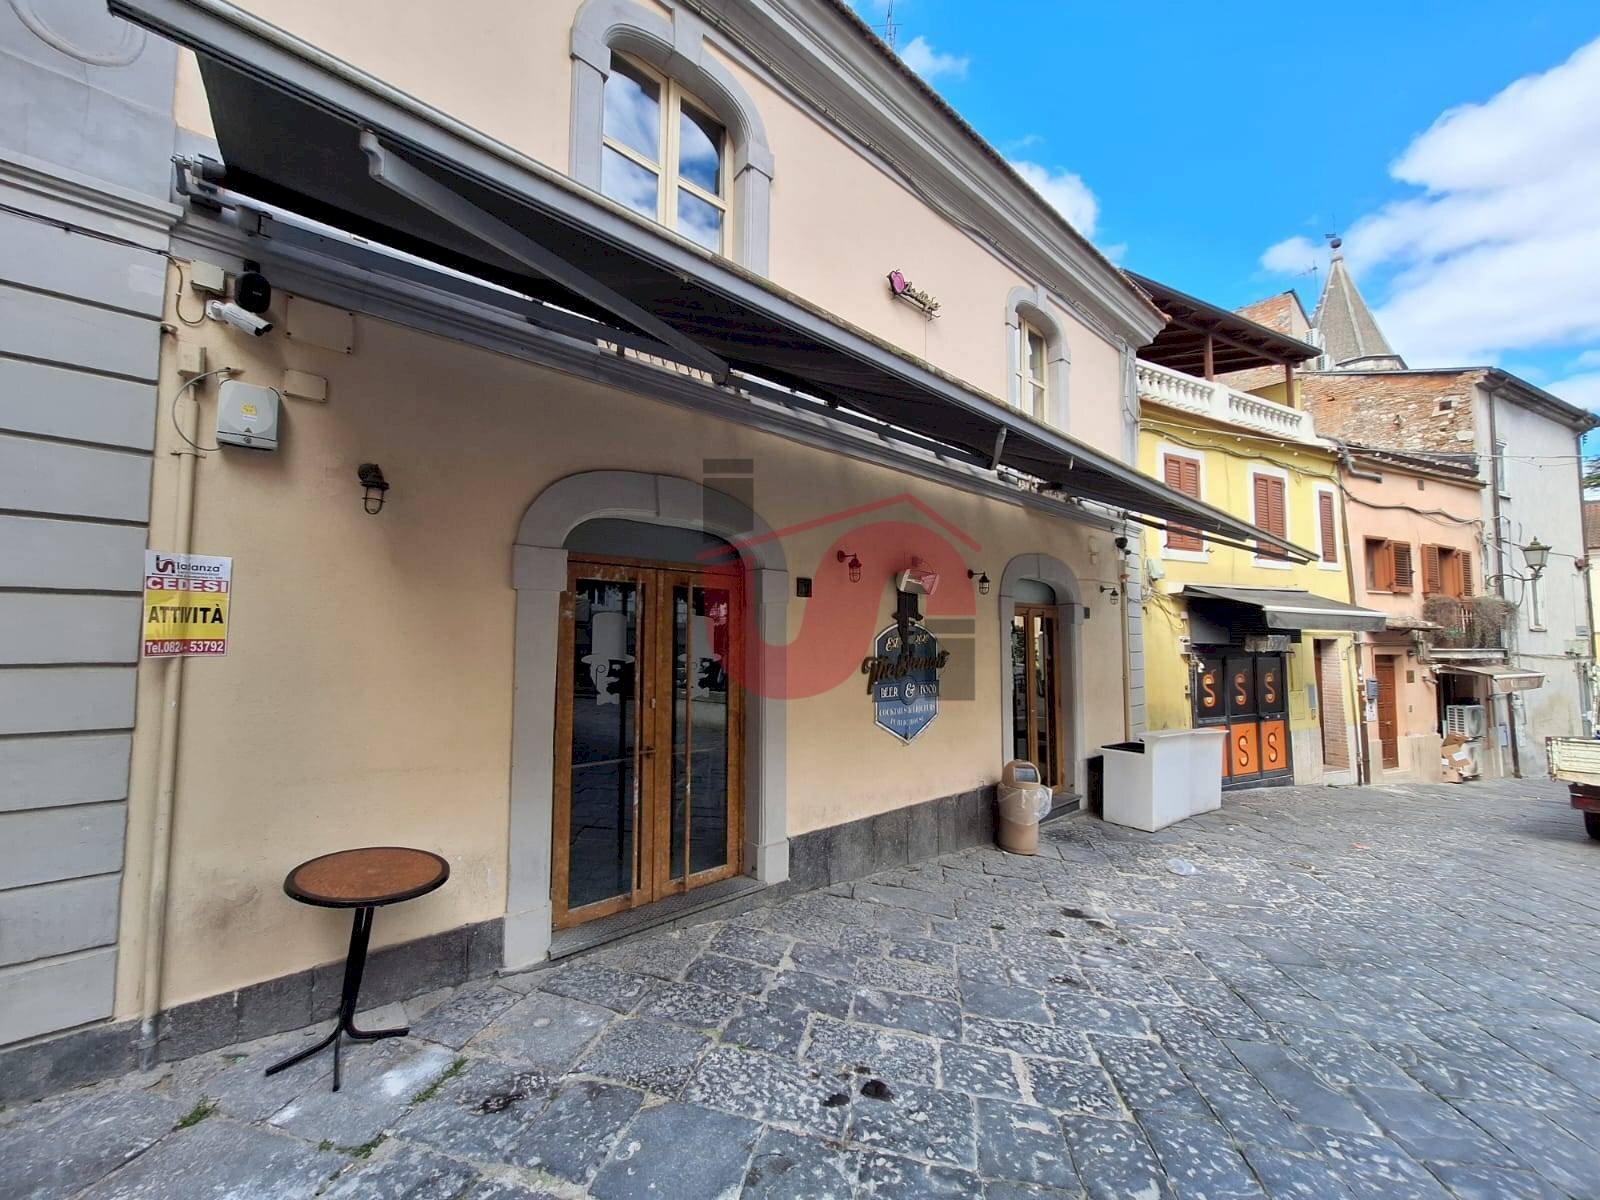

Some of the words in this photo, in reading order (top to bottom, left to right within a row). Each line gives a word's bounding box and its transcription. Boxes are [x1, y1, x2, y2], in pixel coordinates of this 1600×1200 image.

[147, 576, 227, 592] CEDESI
[190, 640, 224, 652] 53792
[880, 686, 898, 698] BEER
